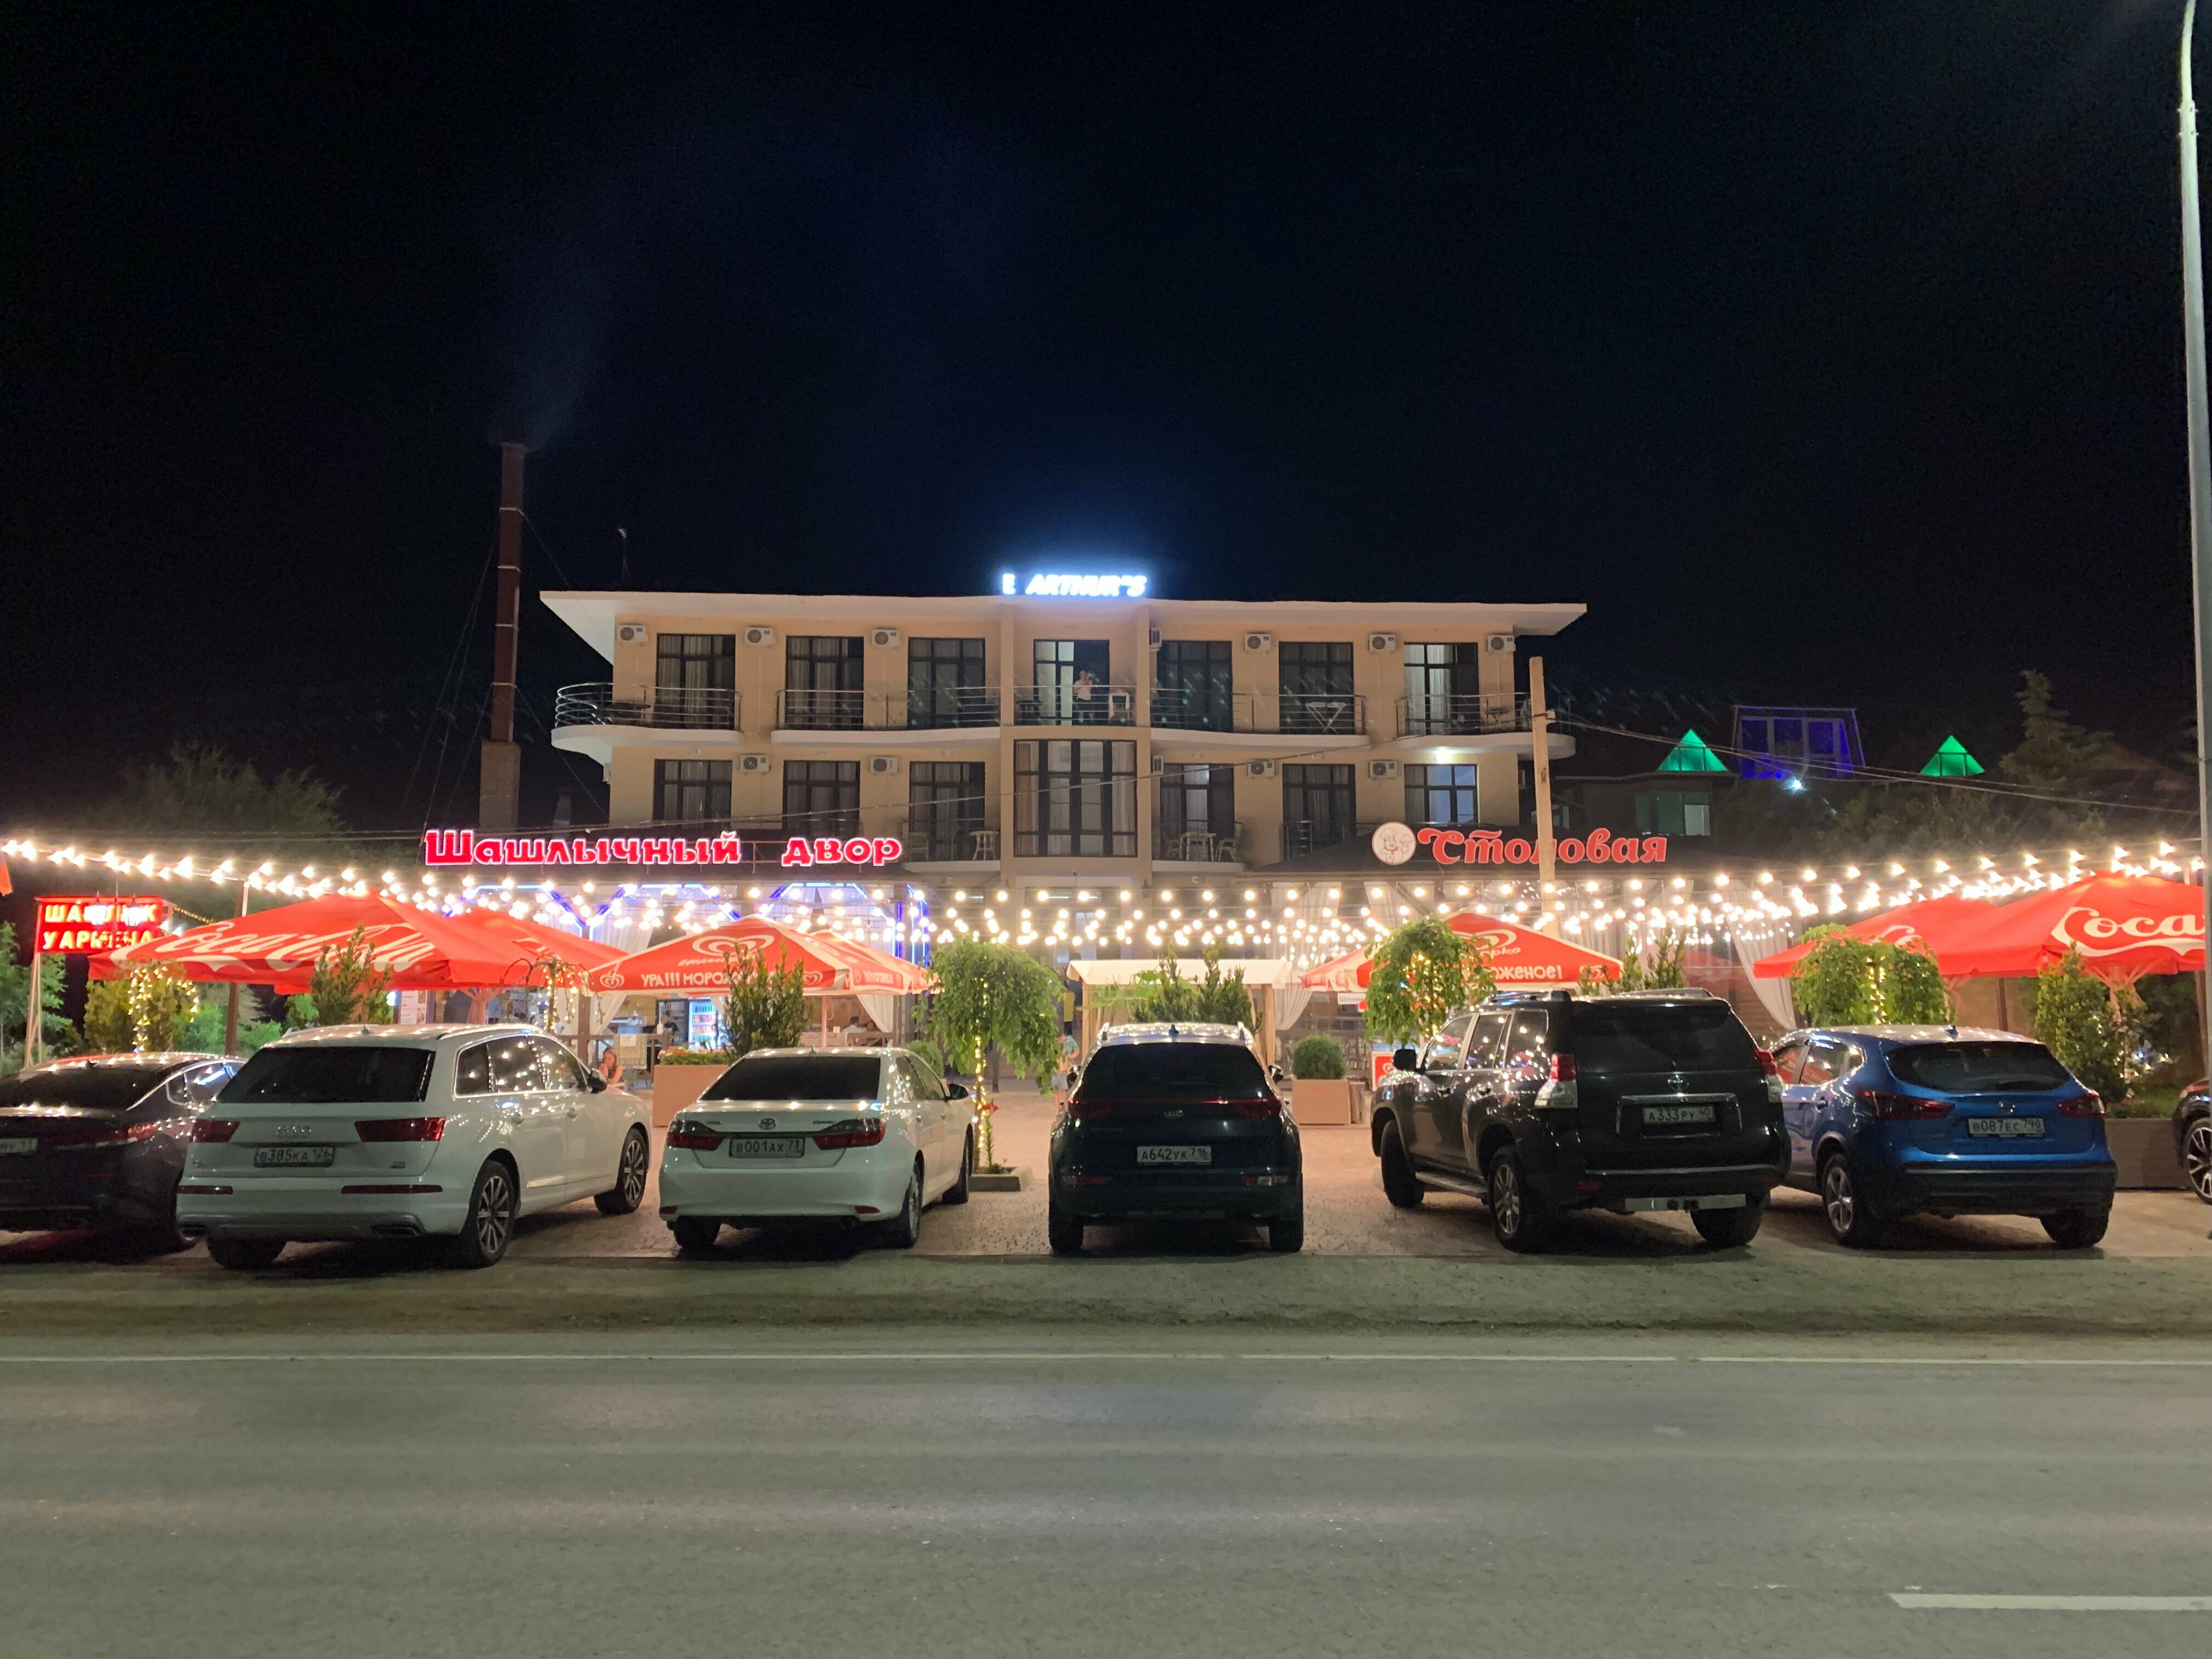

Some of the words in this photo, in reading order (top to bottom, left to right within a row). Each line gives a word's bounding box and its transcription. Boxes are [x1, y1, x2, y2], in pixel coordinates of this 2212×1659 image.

[424, 829, 742, 866] Шашлычный
[44, 904, 157, 923] ШАЛК
[640, 972, 680, 987] УРА!!!
